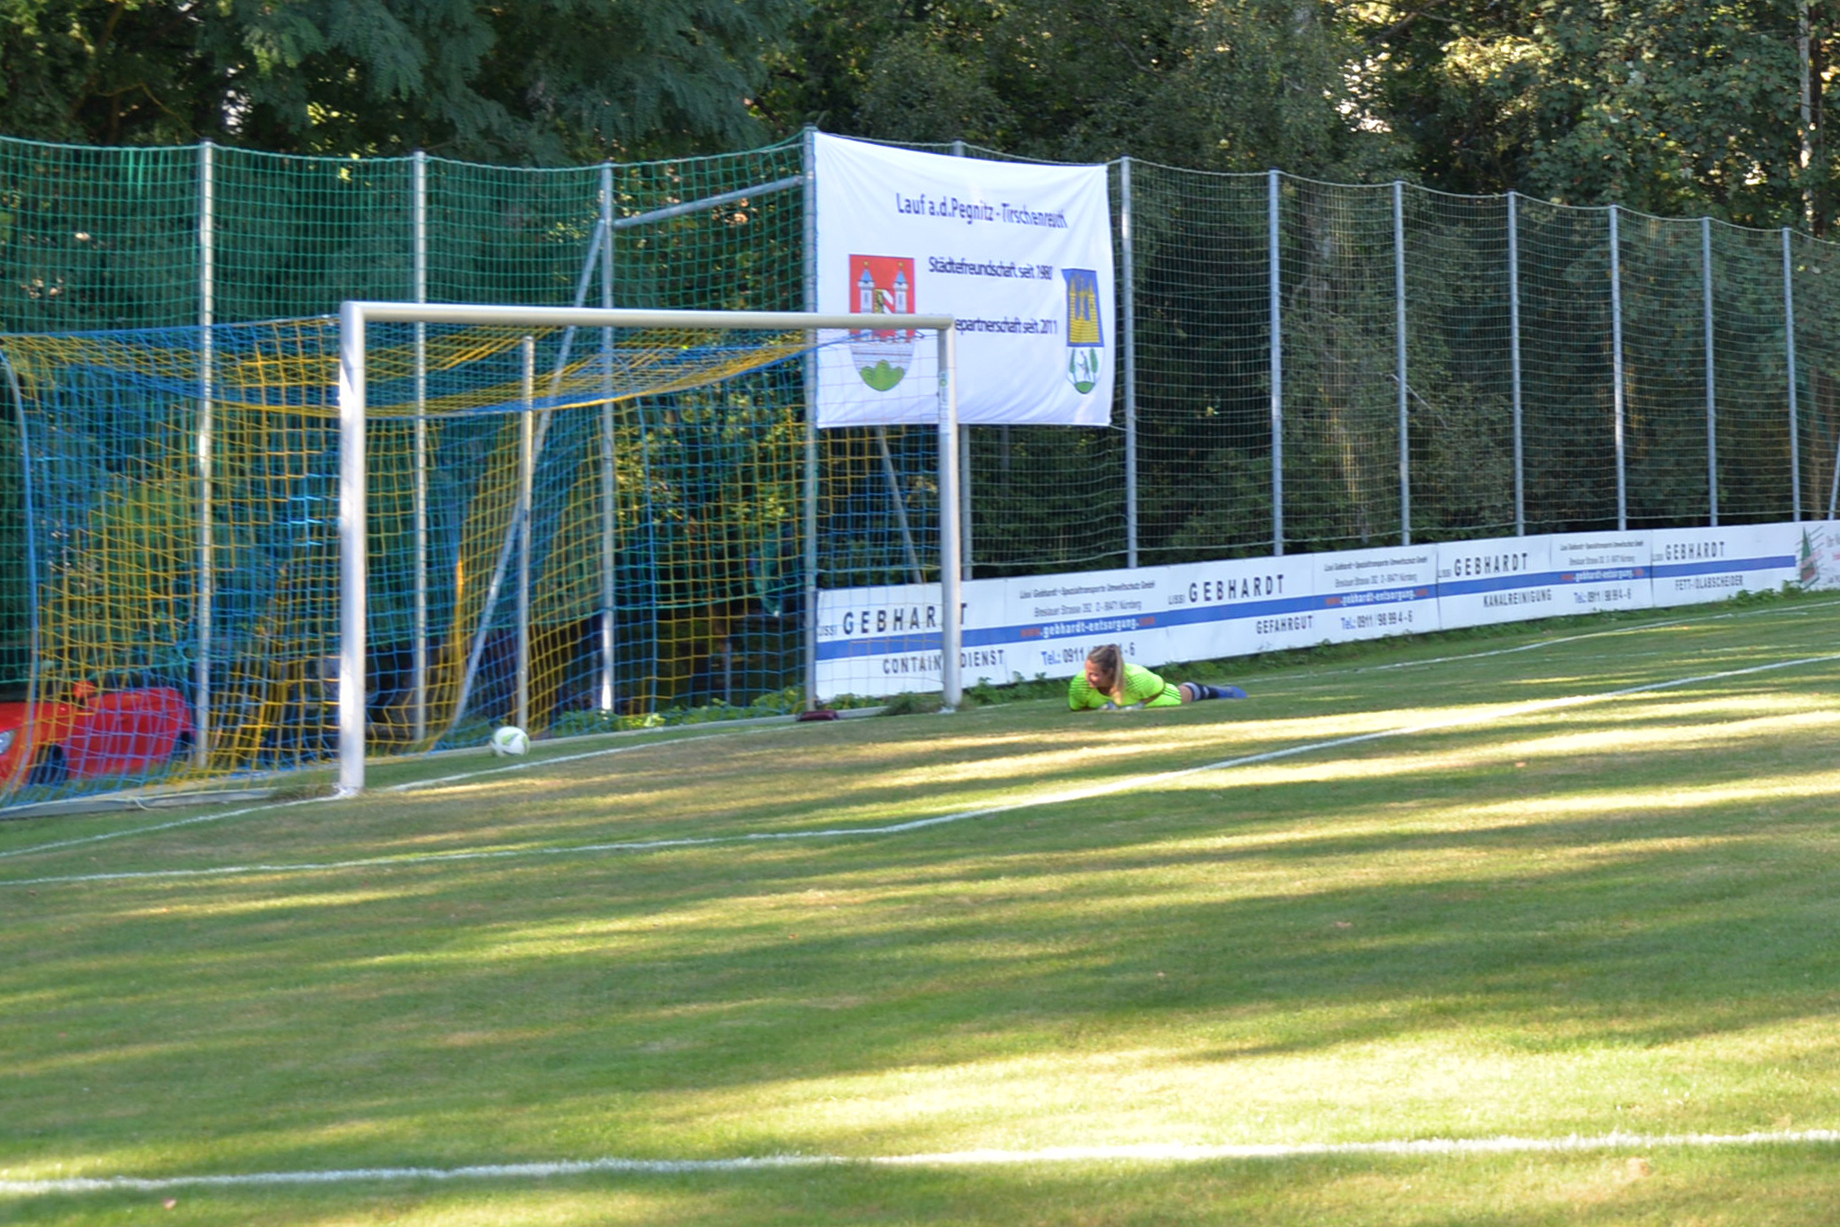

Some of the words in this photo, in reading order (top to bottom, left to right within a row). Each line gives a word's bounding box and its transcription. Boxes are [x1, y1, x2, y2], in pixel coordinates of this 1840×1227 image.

[896, 192, 925, 215] Lauf
[1664, 541, 1725, 561] GEBHARDT
[1454, 552, 1528, 577] GEBHARDT
[1189, 574, 1284, 603] GEBHARDT
[1483, 588, 1552, 608] KANALREINIGUNG
[843, 602, 968, 636] GEBHART
[1256, 615, 1313, 635] GEFAHRGUT
[1062, 647, 1085, 664] 0911
